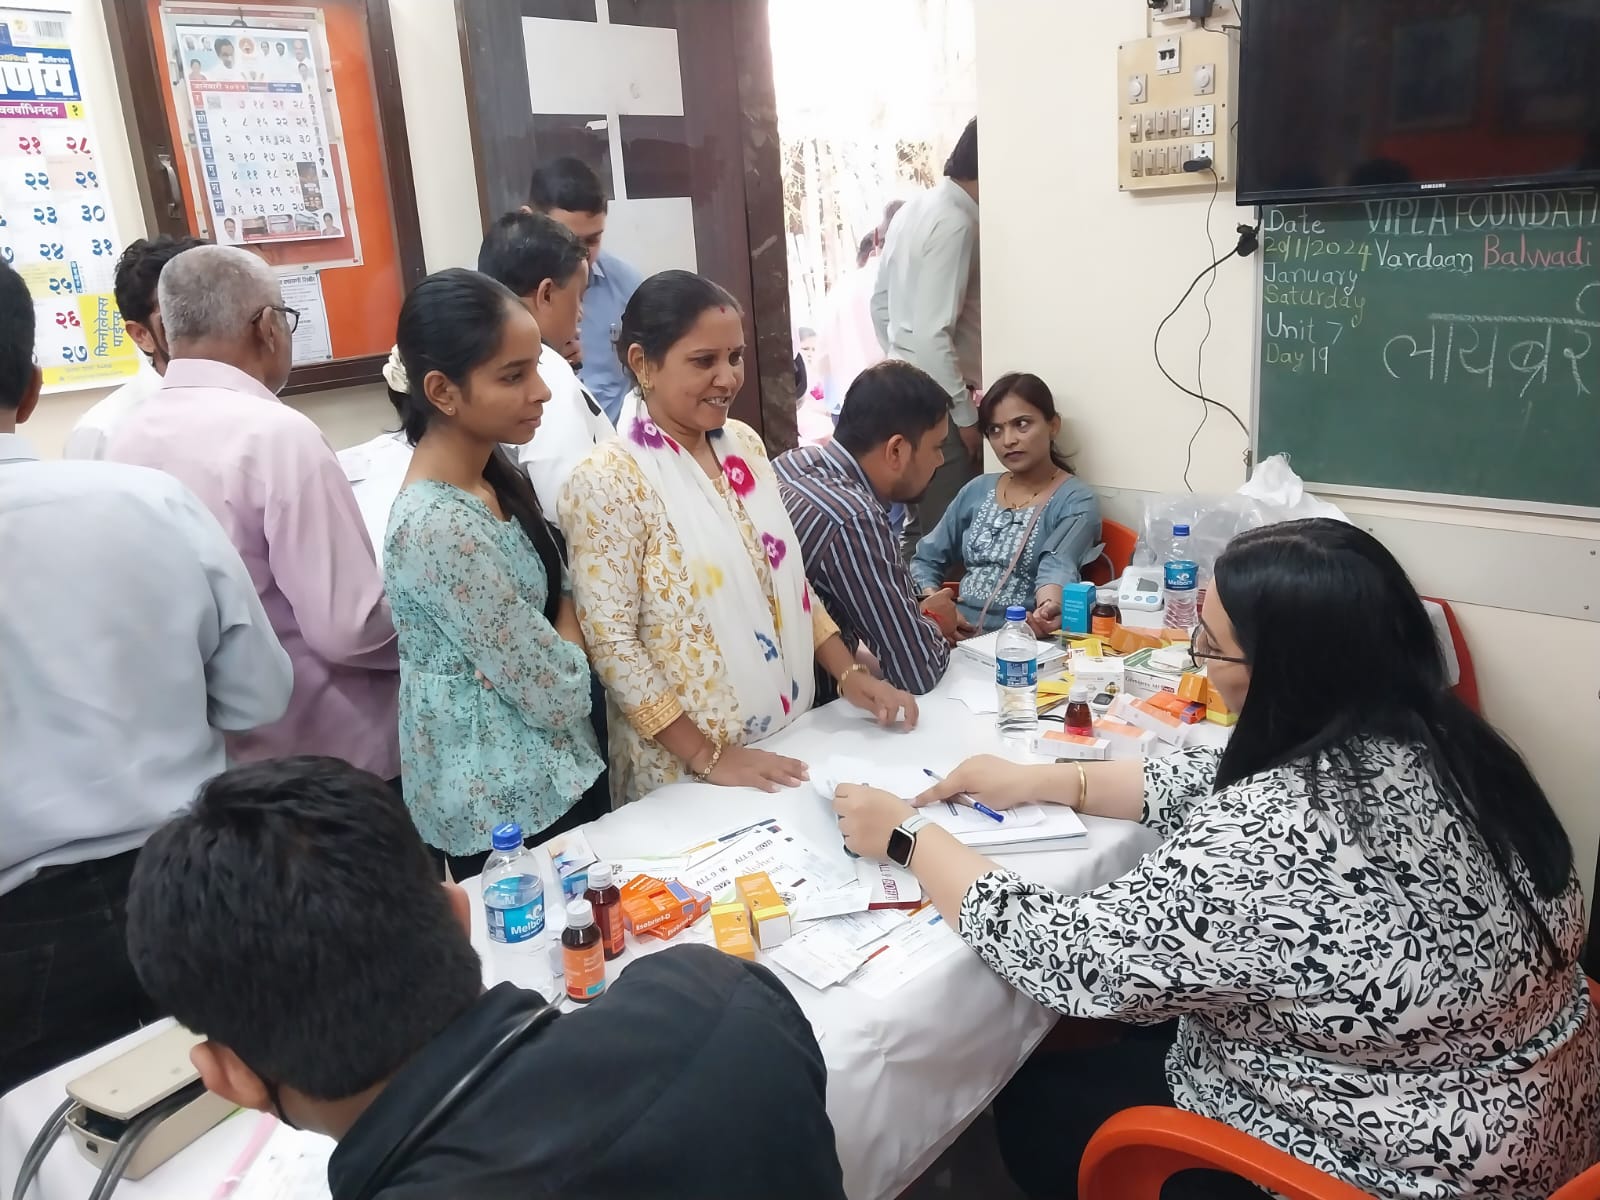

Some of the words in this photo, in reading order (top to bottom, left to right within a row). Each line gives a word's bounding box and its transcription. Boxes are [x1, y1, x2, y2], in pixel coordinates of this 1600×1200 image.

[18, 136, 42, 155] २१
[66, 136, 91, 155] २८
[24, 172, 50, 191] २२
[75, 171, 98, 189] २९
[33, 206, 58, 225] २३
[81, 204, 105, 222] ३०
[1264, 205, 1326, 234] Date
[1363, 198, 1448, 236] VIPLA
[39, 243, 64, 261] २४
[91, 238, 113, 256] ३१
[1374, 237, 1474, 274] Vardaan
[1484, 233, 1592, 270] Balwadi
[48, 278, 73, 295] २५
[1264, 262, 1358, 296] January
[1264, 284, 1366, 328] Saturday
[55, 310, 81, 329] २६
[1266, 311, 1317, 344] Unit
[1326, 321, 1343, 344] 7
[62, 345, 88, 363] २७
[1265, 342, 1304, 372] Day
[1312, 346, 1329, 374] 19
